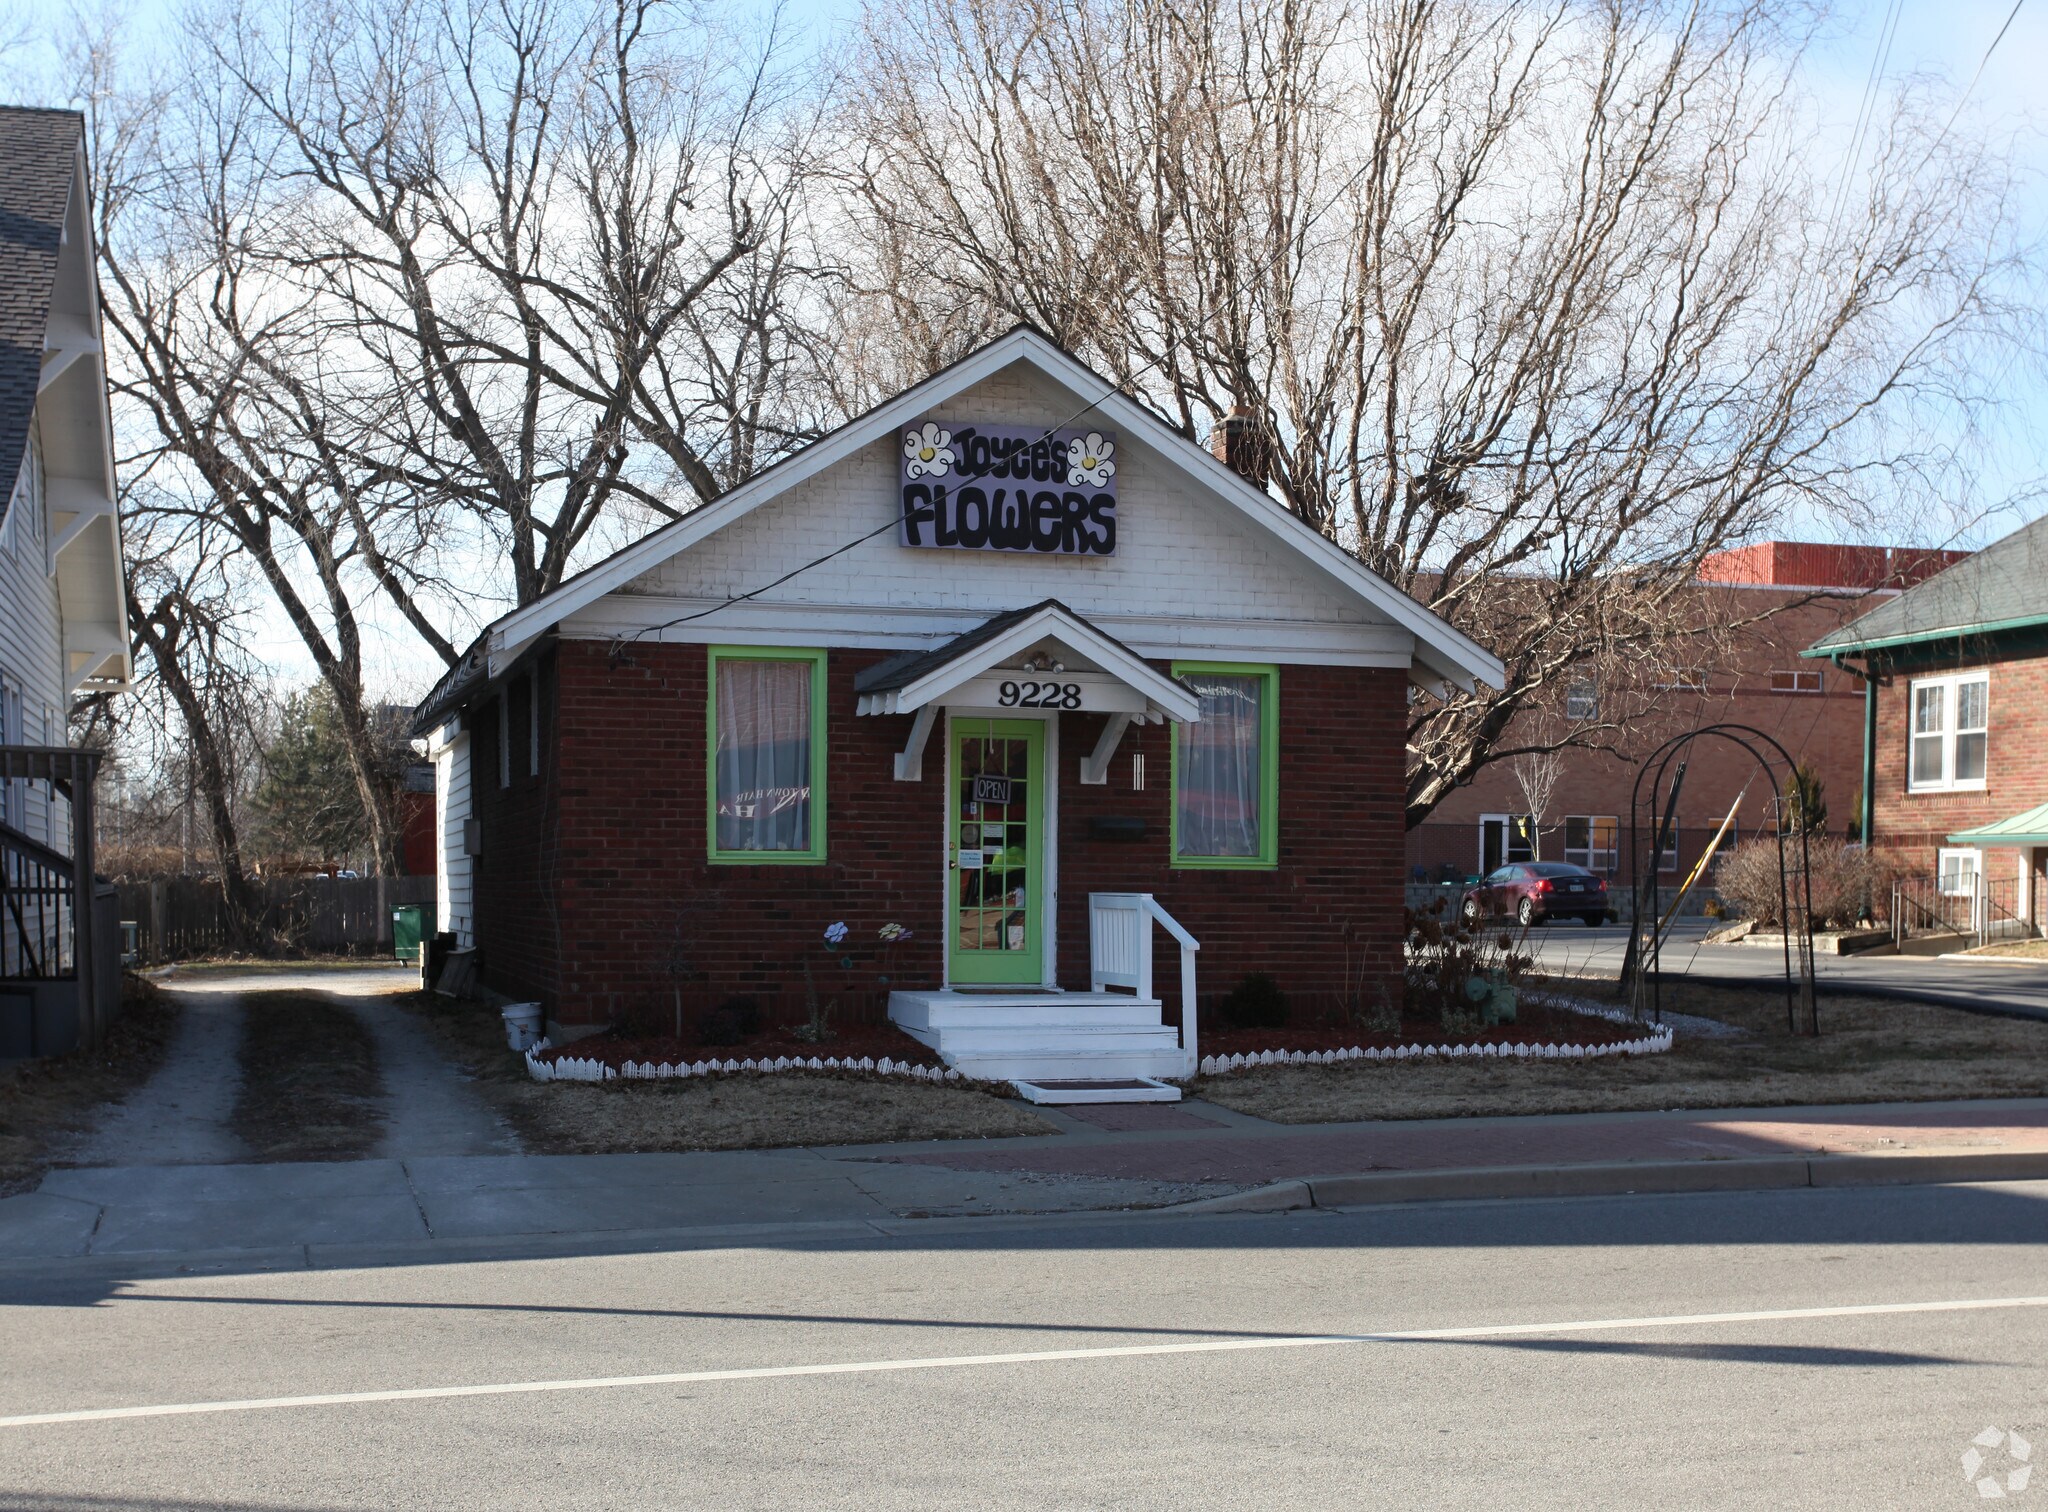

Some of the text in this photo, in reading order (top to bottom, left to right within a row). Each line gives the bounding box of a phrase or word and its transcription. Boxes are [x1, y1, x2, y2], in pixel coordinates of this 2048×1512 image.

[953, 427, 1067, 483] Joyce's
[998, 681, 1082, 709] 9228
[978, 779, 1006, 800] OPEN
